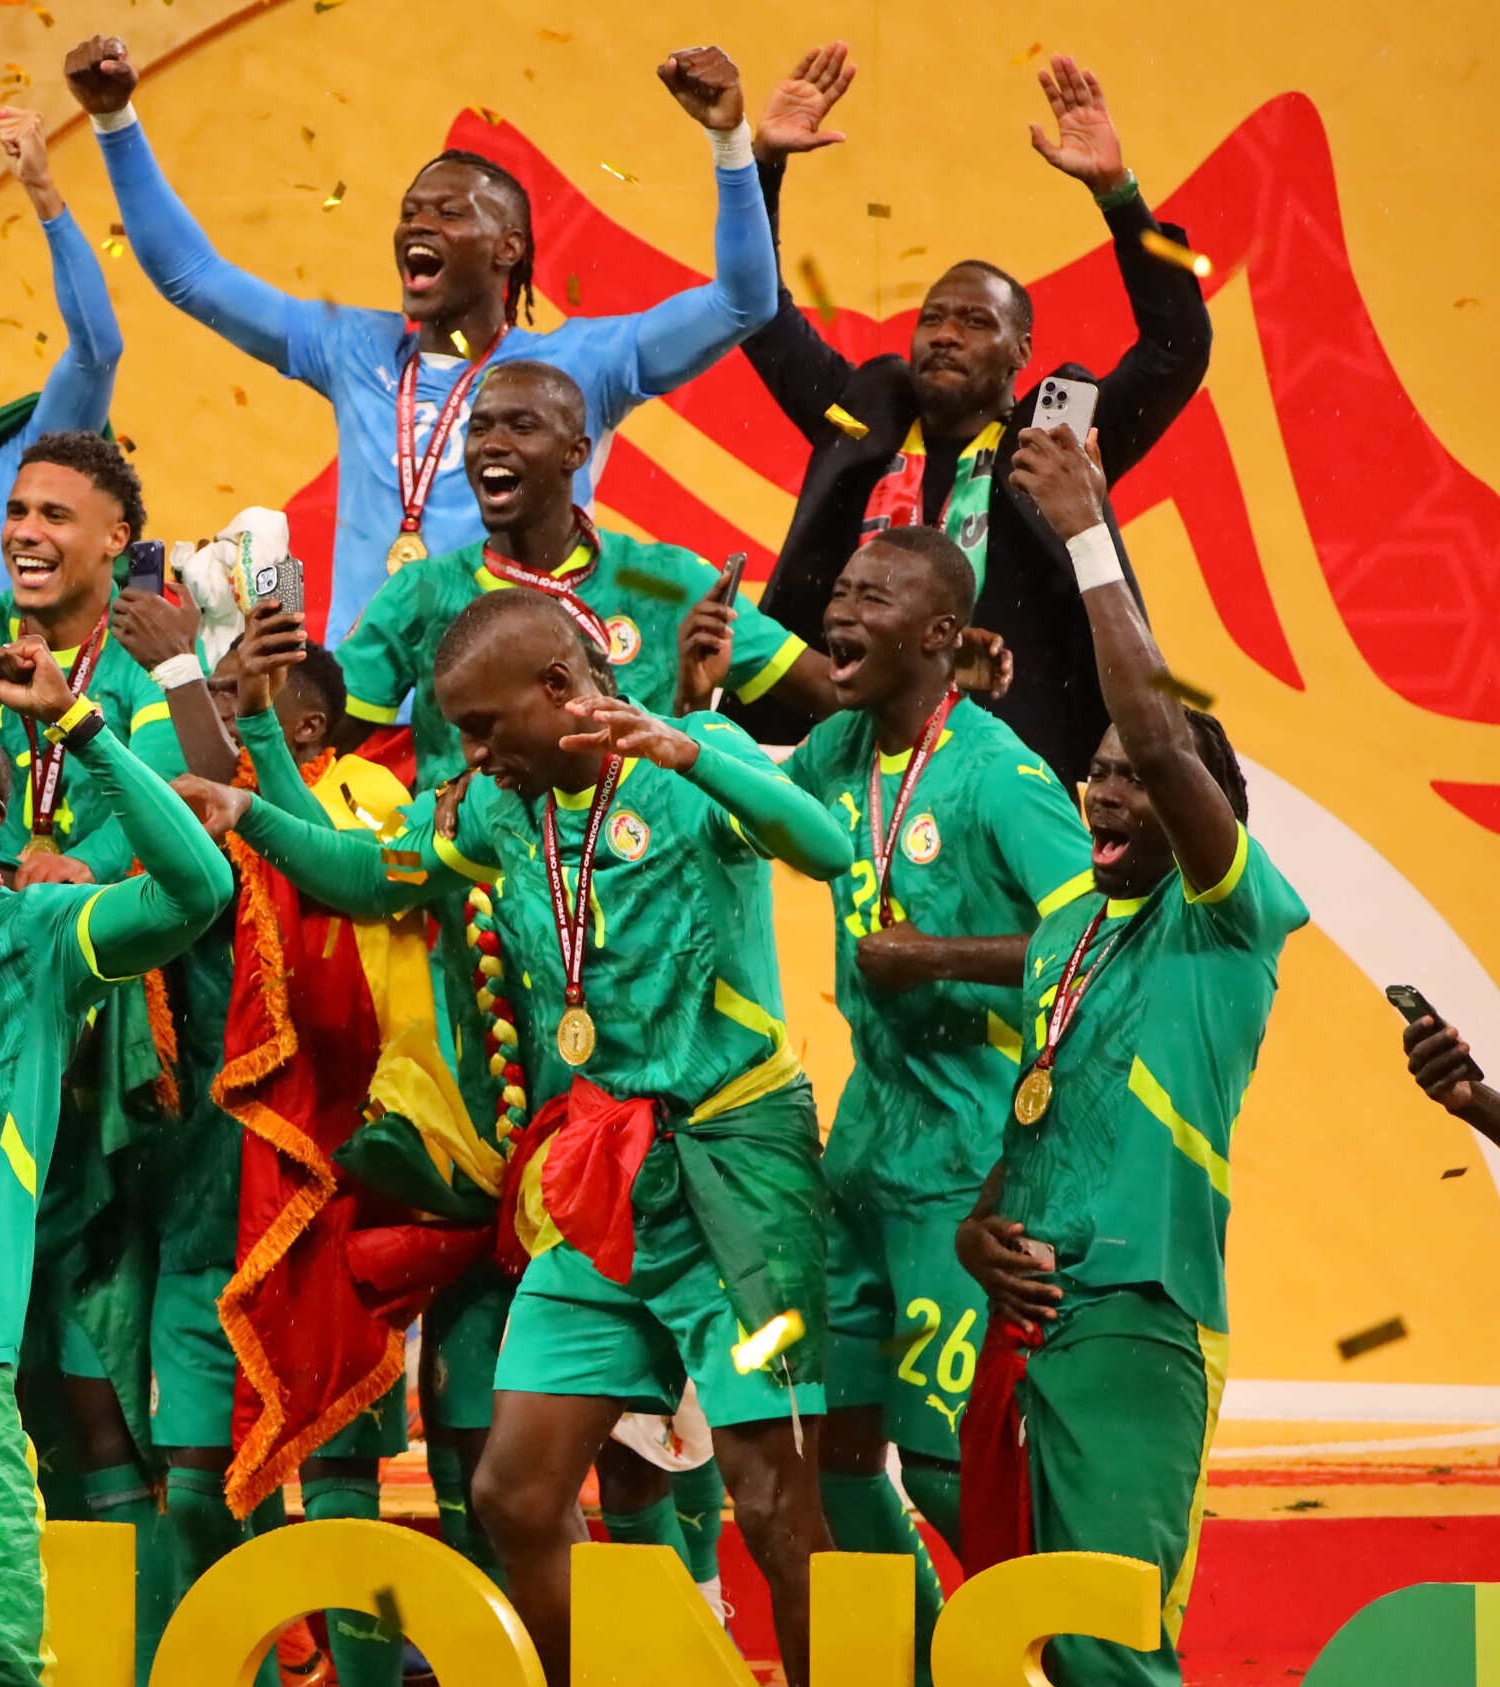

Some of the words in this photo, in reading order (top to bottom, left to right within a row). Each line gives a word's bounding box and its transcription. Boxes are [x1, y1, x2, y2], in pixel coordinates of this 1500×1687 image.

[586, 811, 601, 852] NATIONS
[597, 761, 619, 809] MOROCCO
[551, 870, 560, 889] CUP
[555, 890, 565, 924] AFRICA
[898, 1297, 978, 1393] 26
